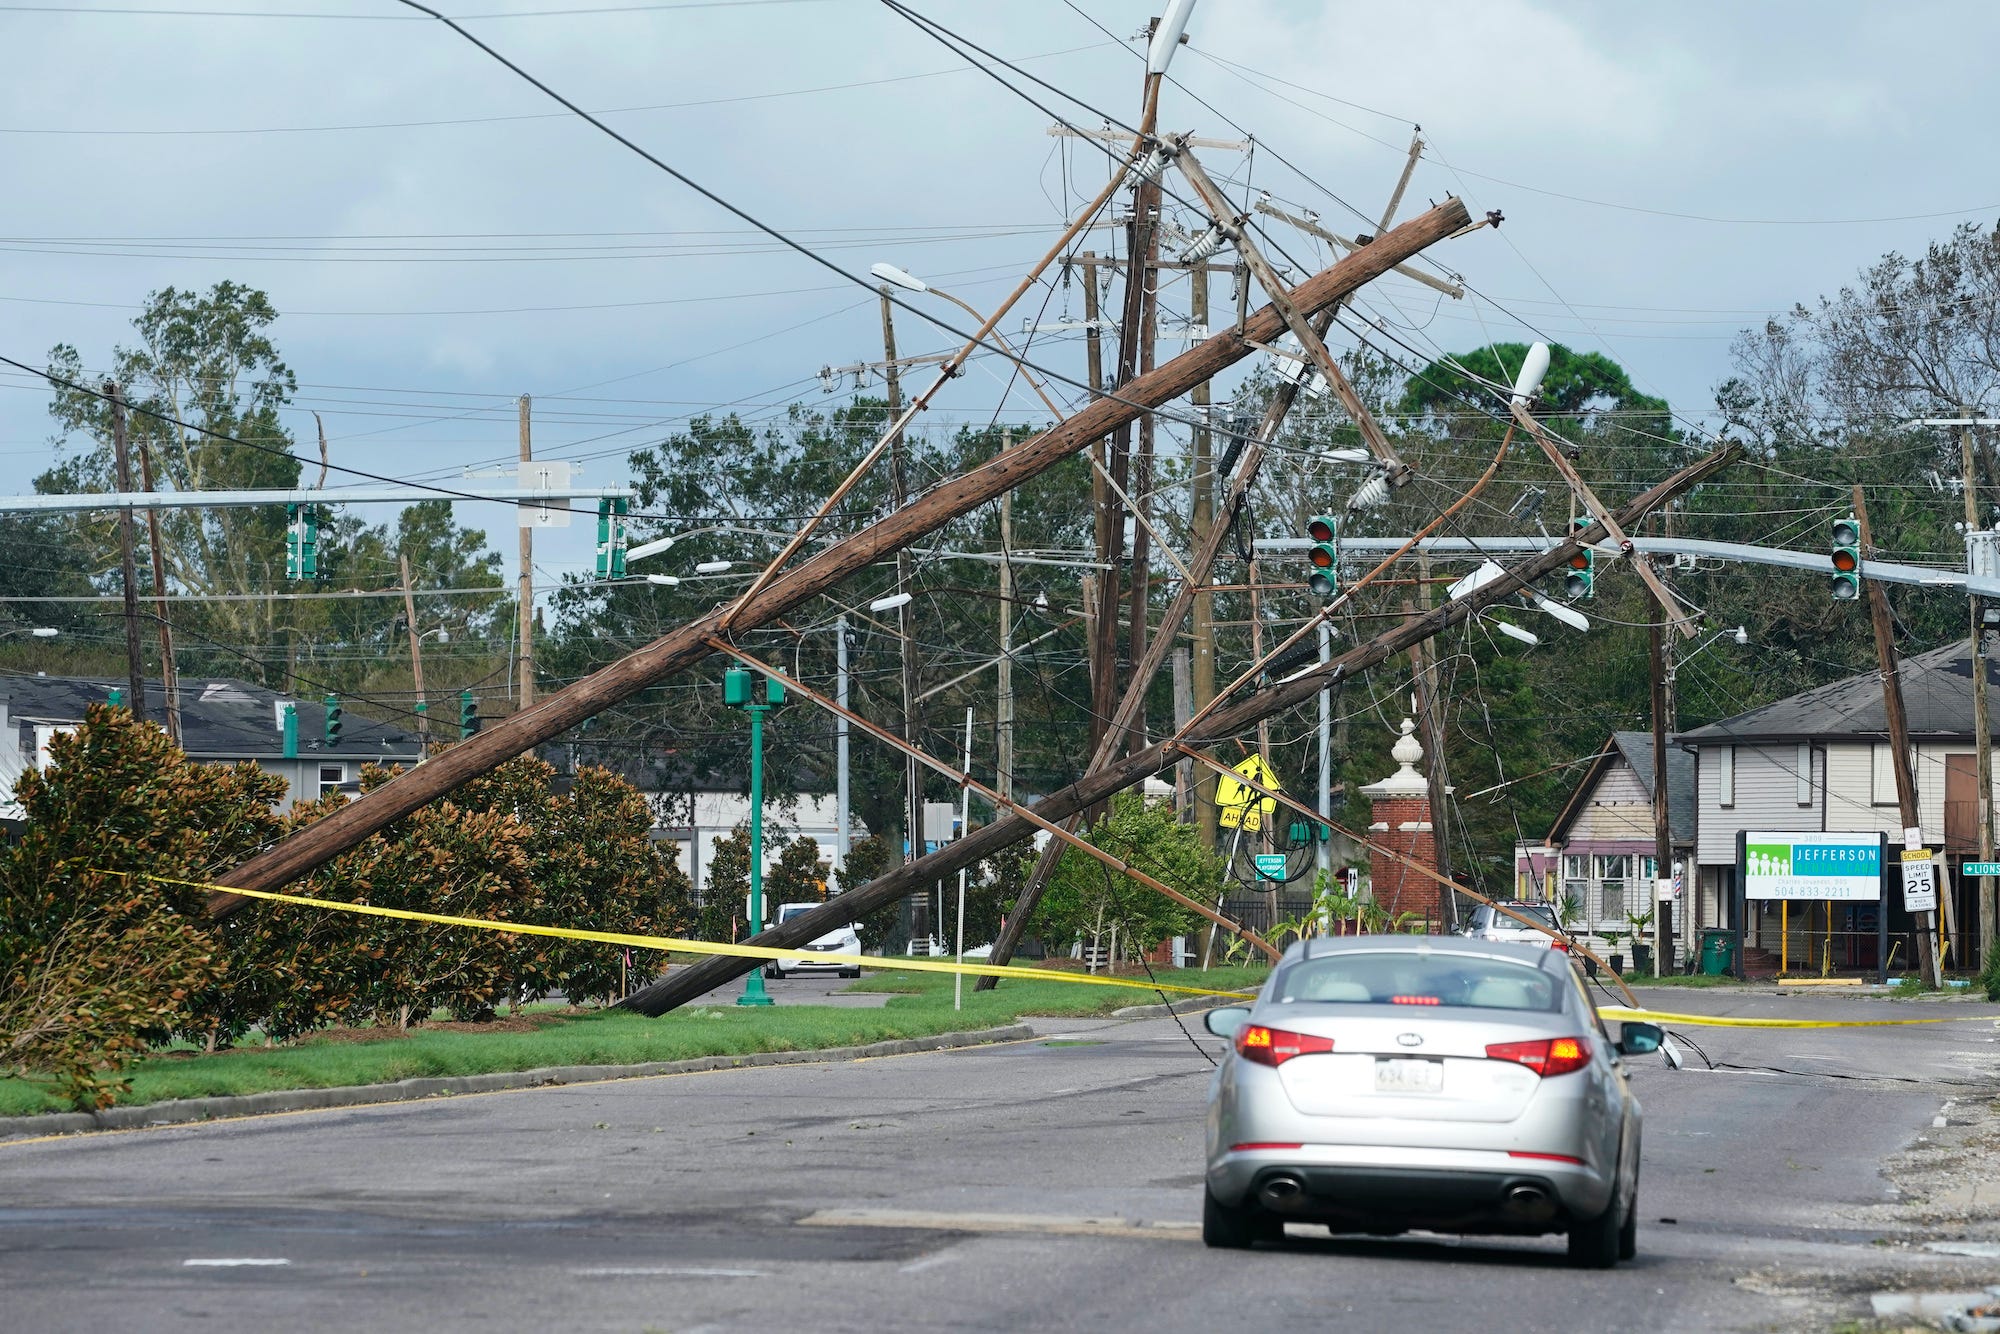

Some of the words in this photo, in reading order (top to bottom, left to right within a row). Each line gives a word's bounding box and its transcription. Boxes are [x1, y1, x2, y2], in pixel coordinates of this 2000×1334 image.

[1223, 812, 1259, 827] AHAD
[1796, 849, 1876, 861] JEFFERSON
[1903, 852, 1930, 860] SCHOOL
[1905, 863, 1930, 871] SPEED
[1974, 864, 2000, 874] LIONS
[1908, 871, 1927, 879] LIMIT
[1907, 878, 1931, 894] 25
[1774, 886, 1850, 897] 504-833-2211
